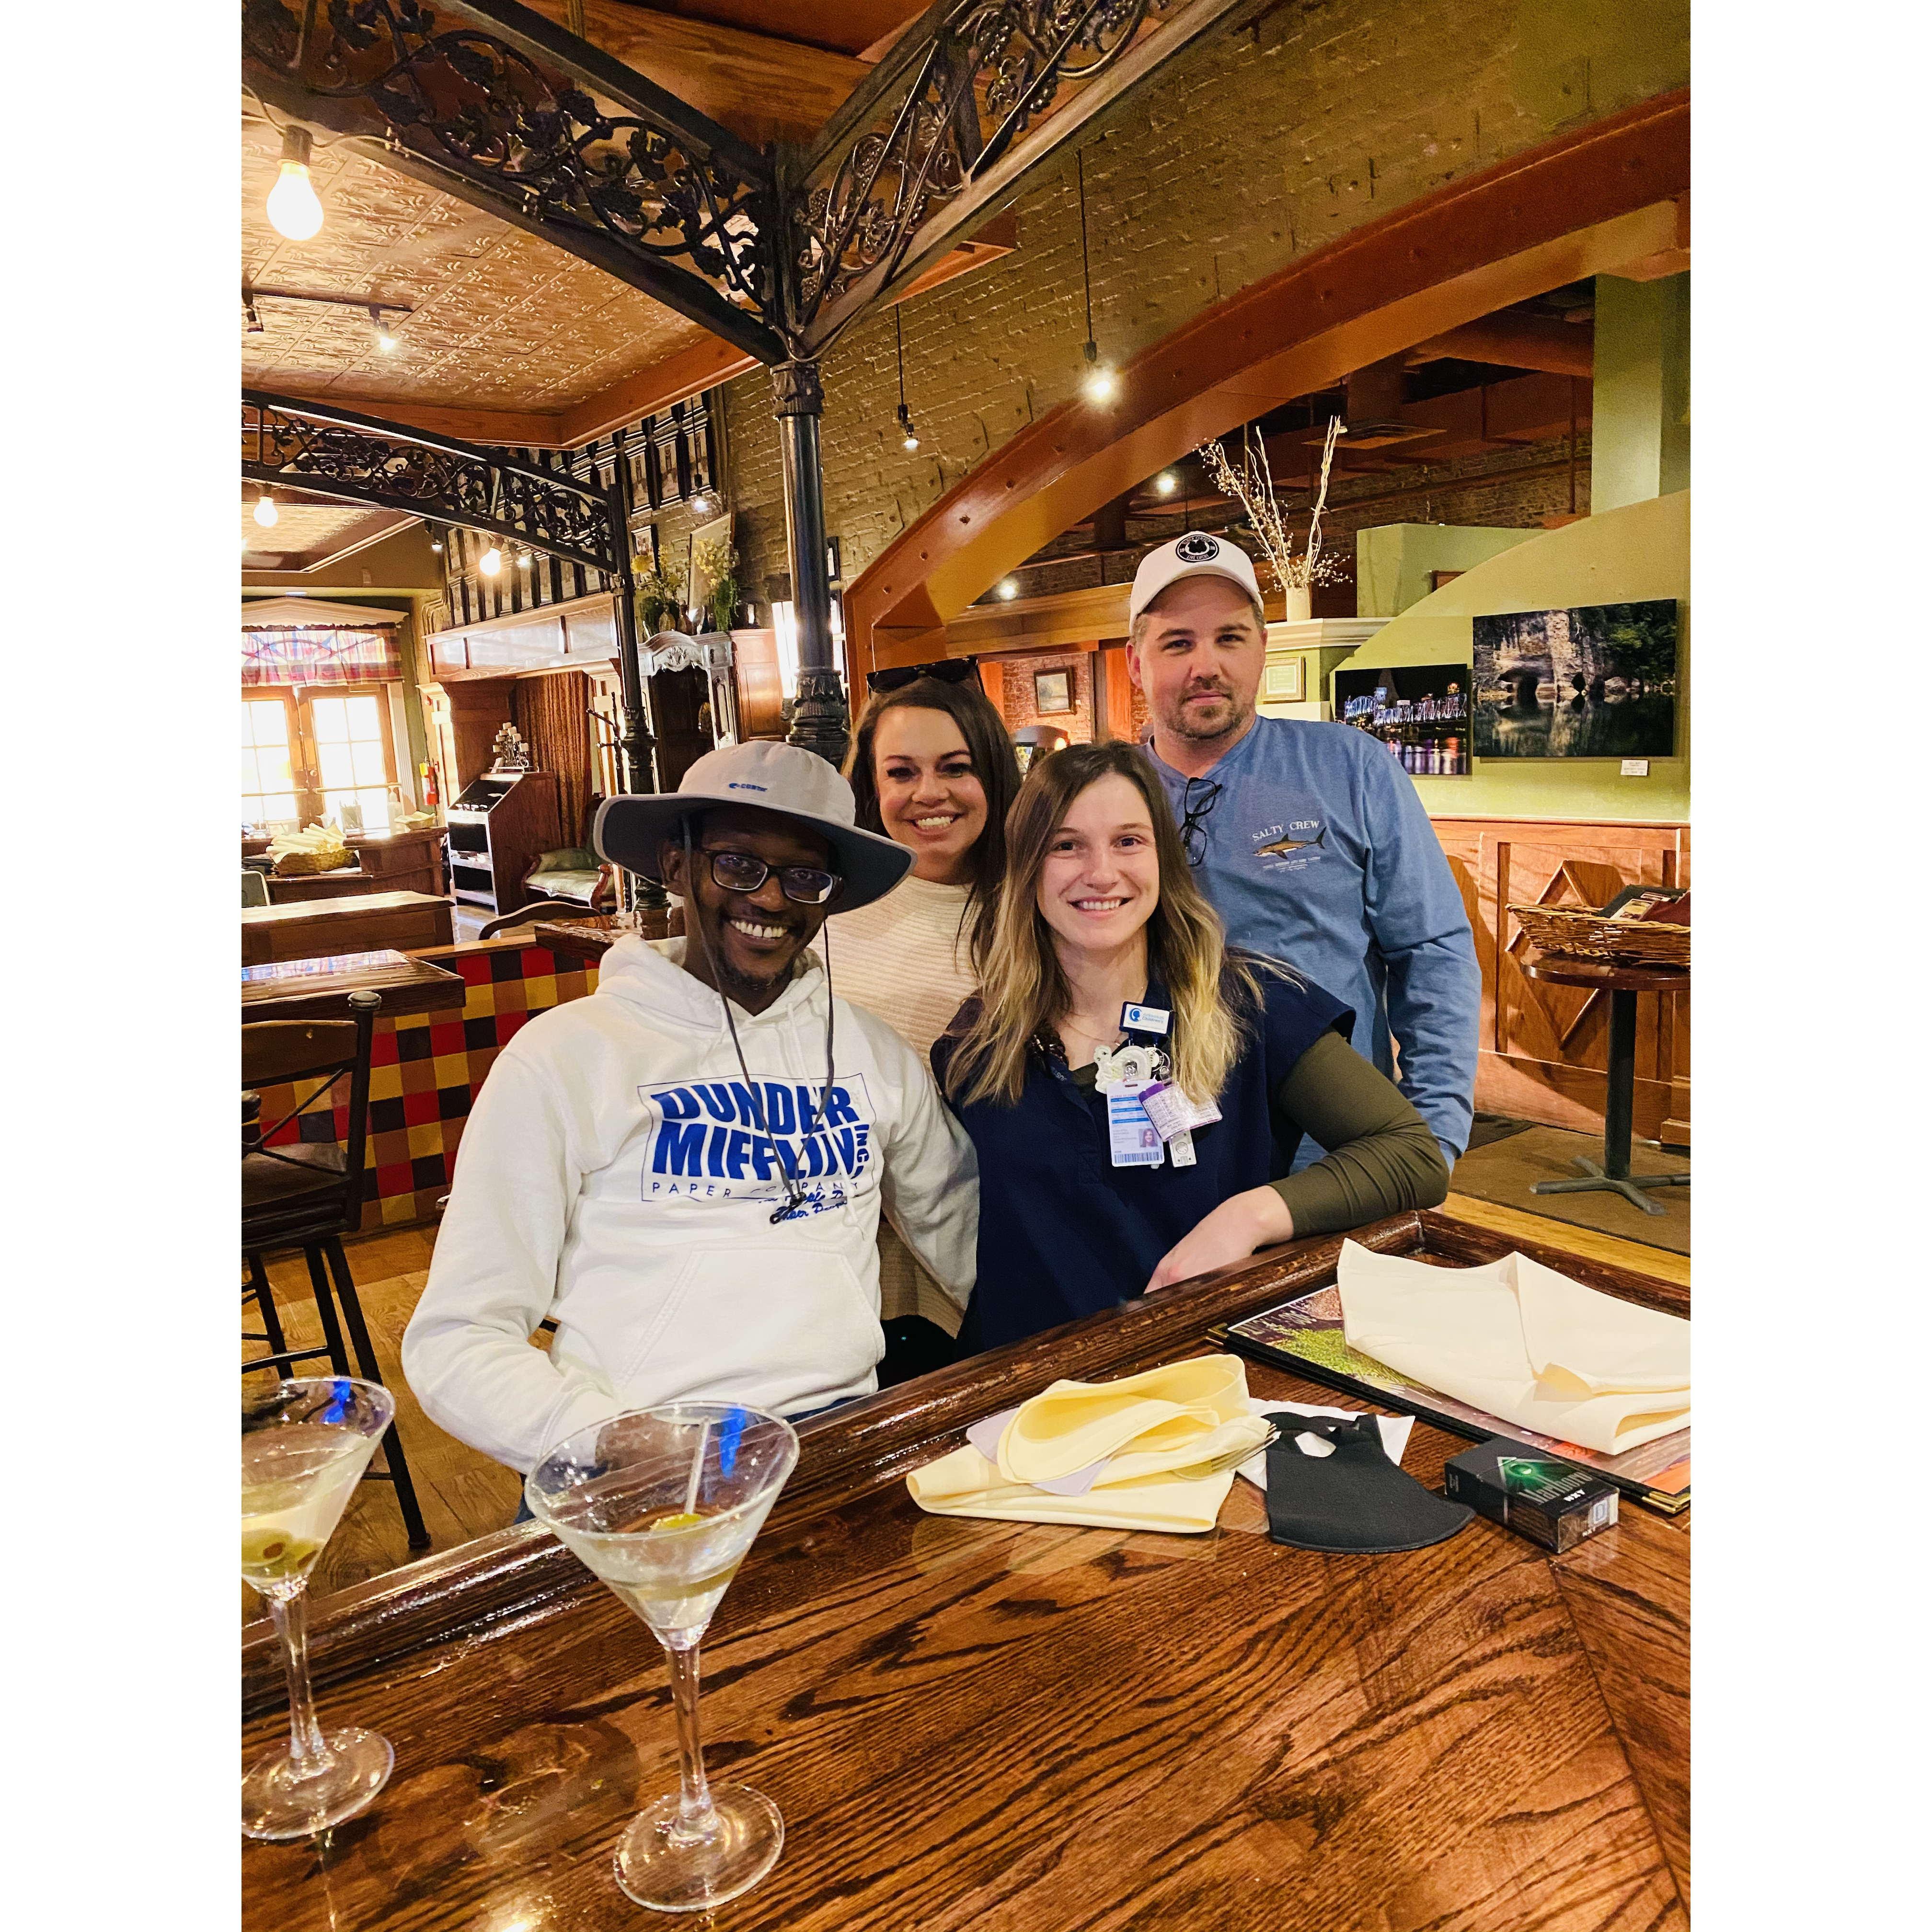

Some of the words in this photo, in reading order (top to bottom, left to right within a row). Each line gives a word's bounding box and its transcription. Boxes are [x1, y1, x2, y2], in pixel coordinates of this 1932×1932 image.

[1252, 824, 1285, 842] SALTY
[1289, 820, 1320, 830] CREW
[650, 1081, 860, 1135] DUNDER
[652, 1182, 732, 1198] PAPER
[1517, 1472, 1593, 1505] Marlboro
